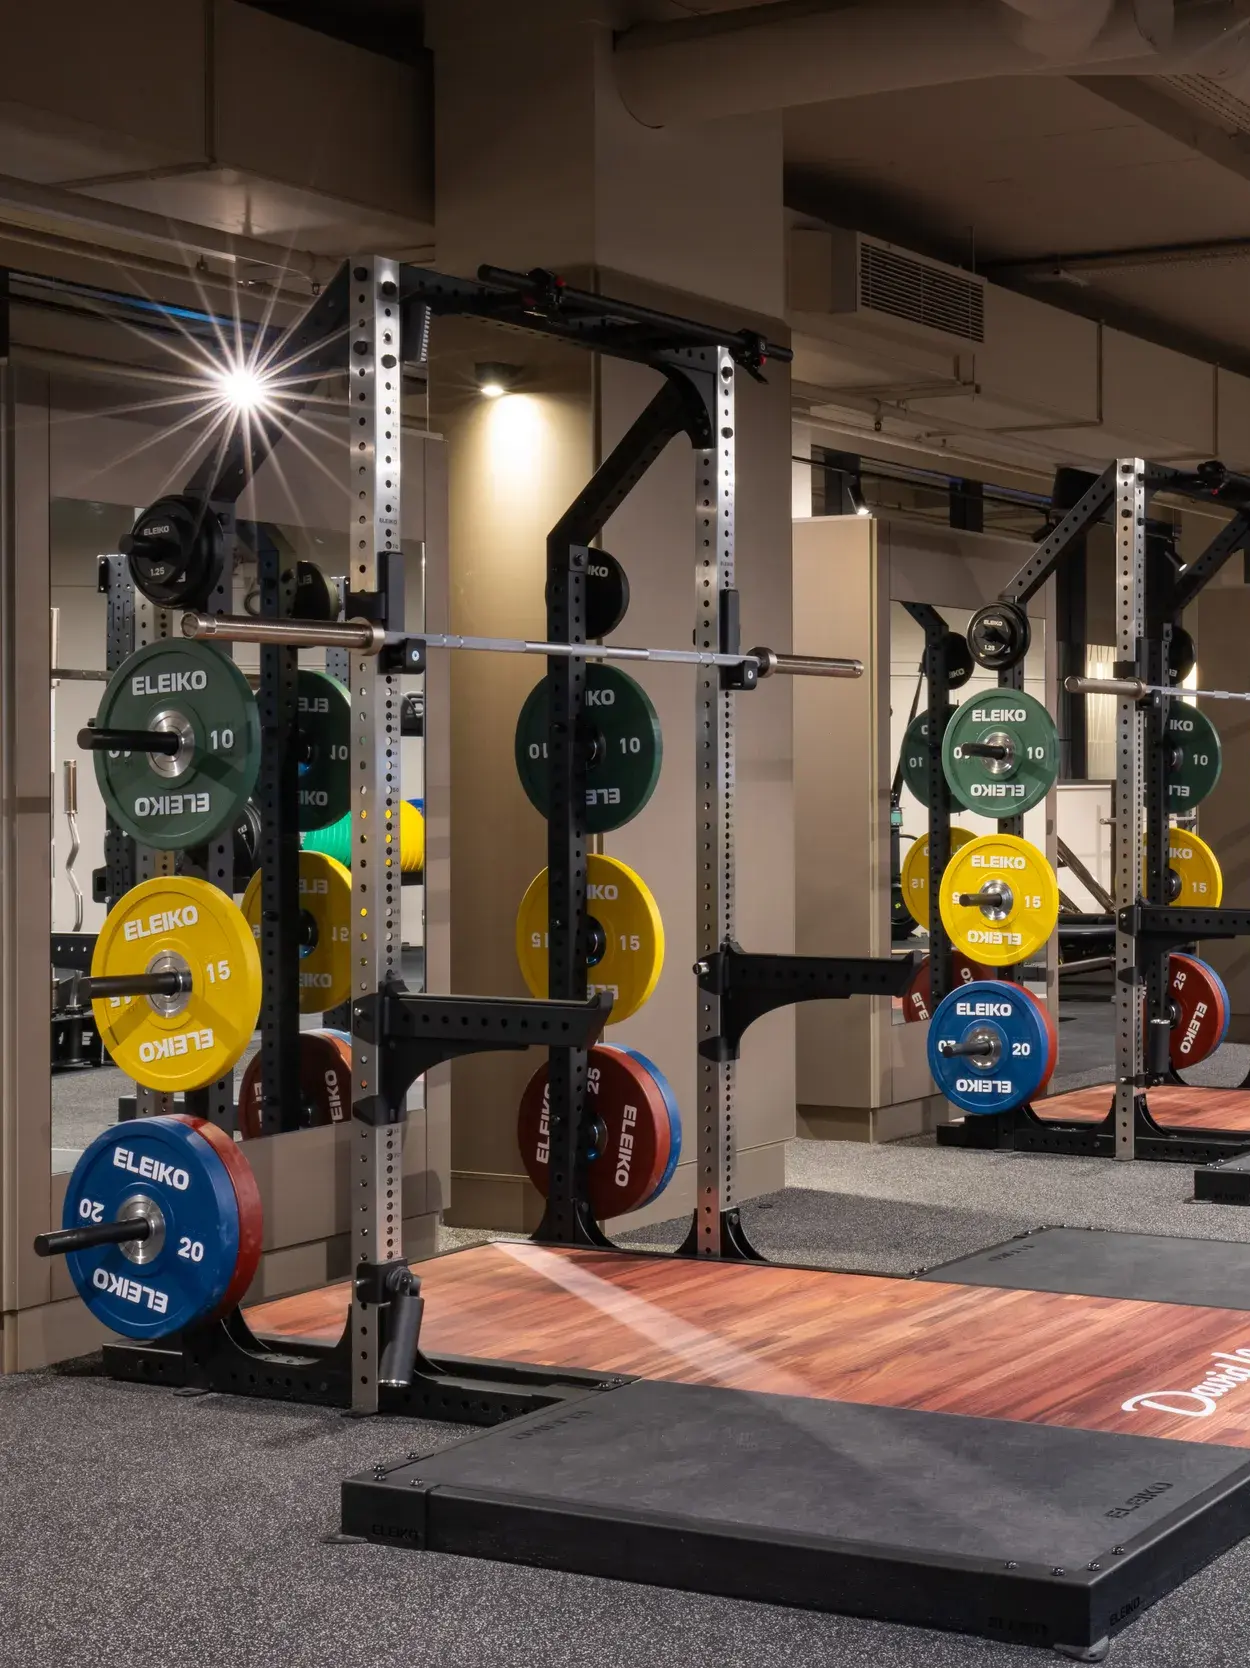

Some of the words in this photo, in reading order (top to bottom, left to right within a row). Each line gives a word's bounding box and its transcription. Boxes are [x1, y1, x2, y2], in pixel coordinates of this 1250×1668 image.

[143, 525, 170, 536] ELEIKO
[150, 567, 165, 577] 1.25
[132, 670, 207, 695] ELEIKO
[972, 709, 1027, 723] ELEIKO
[210, 729, 234, 749] 10
[619, 737, 641, 755] 10
[1027, 746, 1044, 760] 10
[1192, 754, 1209, 766] 10
[970, 784, 1025, 797] ELEIKO
[135, 793, 210, 816] ELEIKO
[971, 855, 1026, 869] ELEIKO
[1191, 881, 1208, 893] 15
[1024, 895, 1041, 908] 15
[124, 905, 198, 941] ELEIKO
[619, 934, 640, 951] 15
[967, 930, 1022, 945] ELEIKO
[207, 960, 231, 983] 15
[1172, 970, 1187, 991] 25
[956, 1003, 1012, 1016] ELEIKO
[1179, 1001, 1208, 1054] ELEIKO
[139, 1028, 214, 1062] ELEIKO
[1012, 1043, 1031, 1056] 20
[586, 1067, 600, 1095] 25
[956, 1079, 1012, 1093] ELEIKO
[614, 1104, 638, 1188] ELEIKO
[113, 1147, 190, 1190] ELEIKO
[79, 1198, 105, 1222] 20
[178, 1237, 204, 1262] 20
[93, 1268, 168, 1313] ELEIKO
